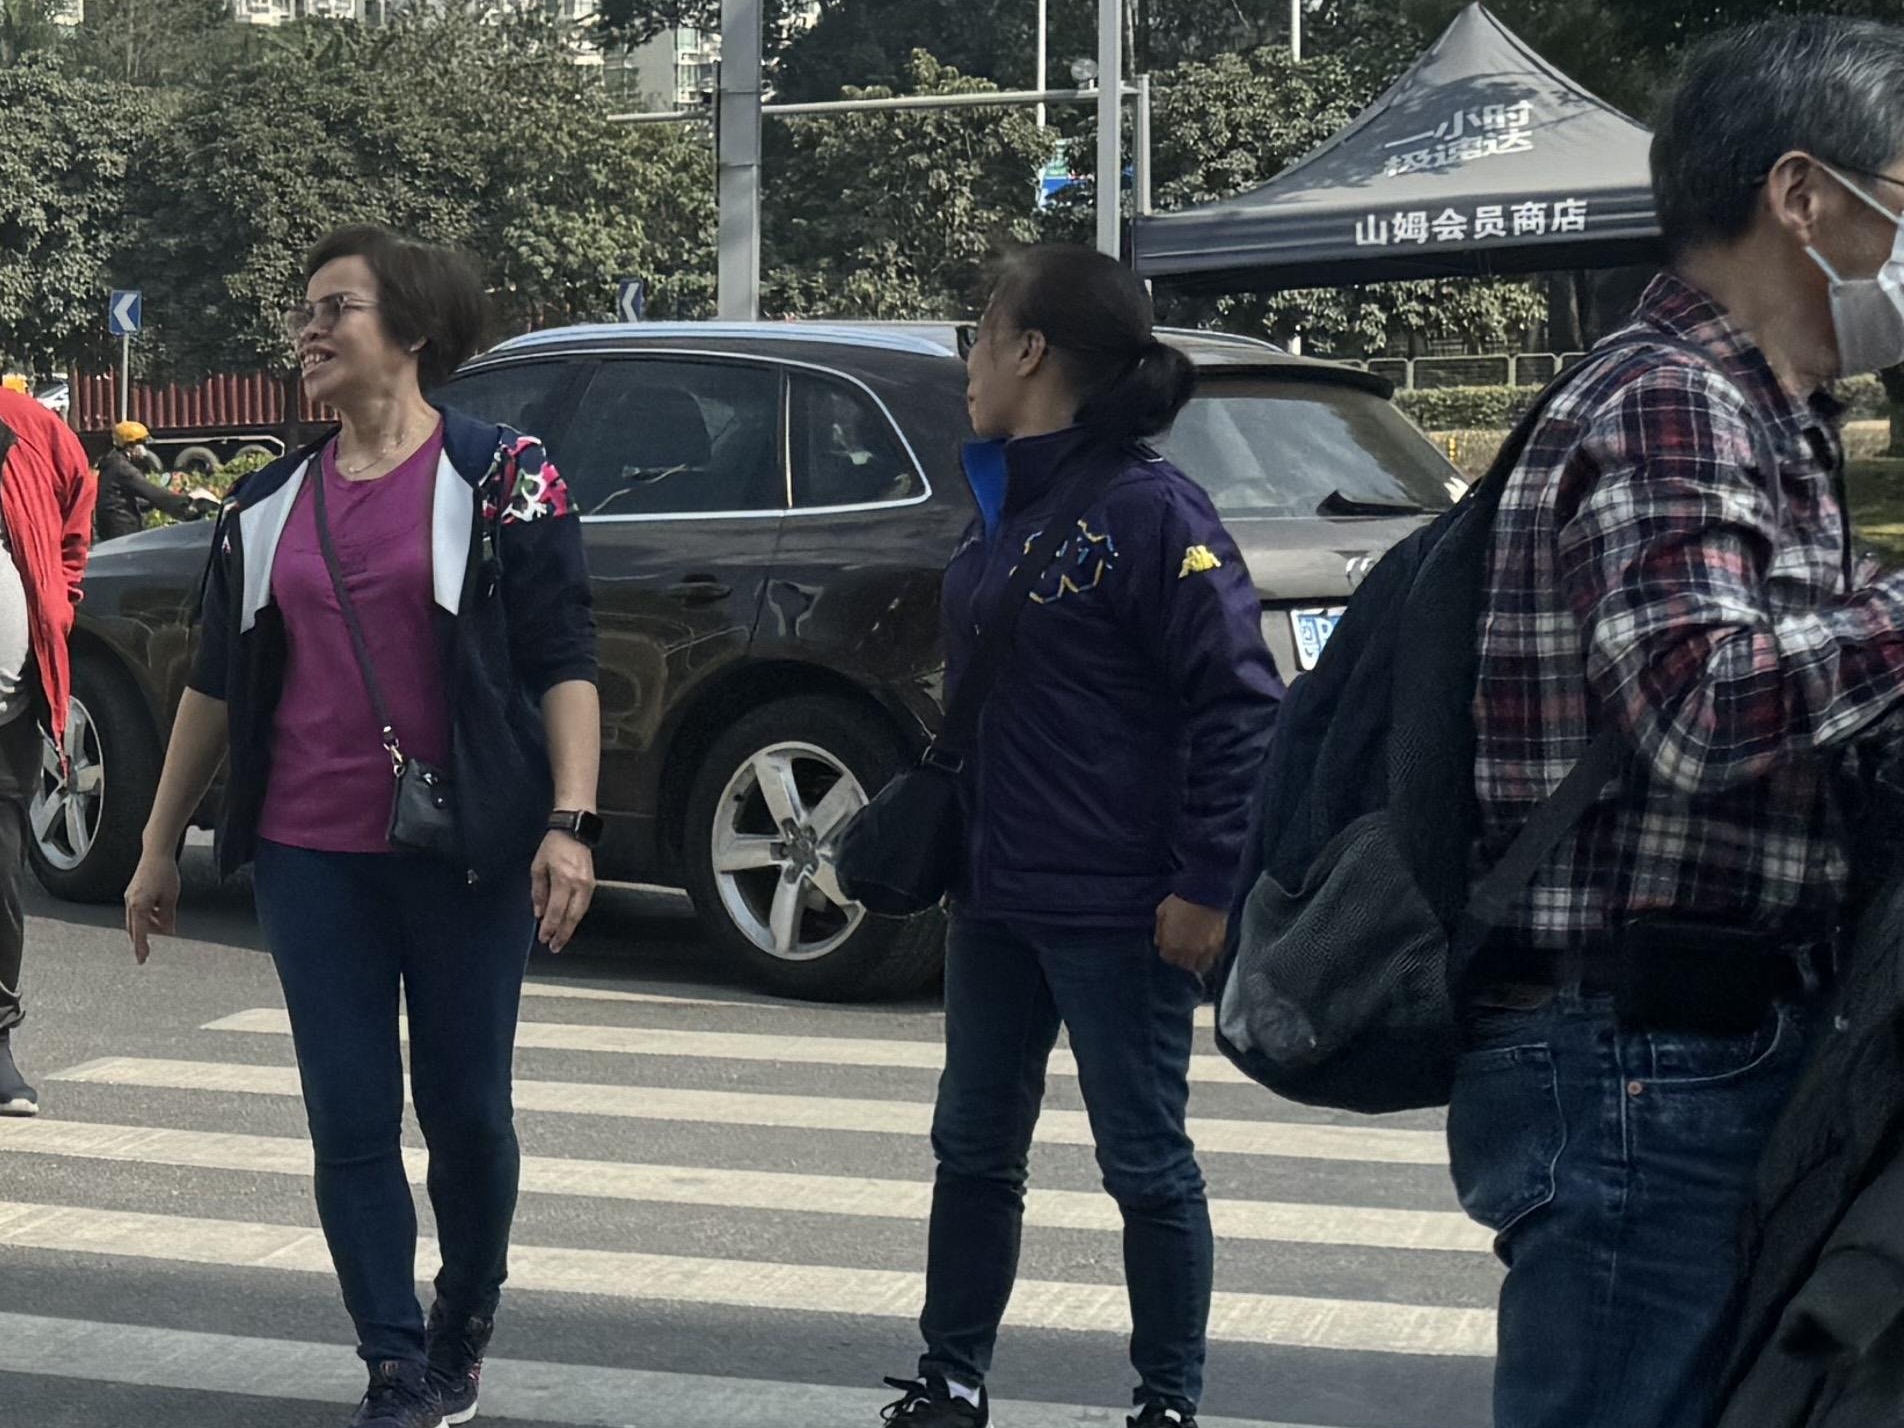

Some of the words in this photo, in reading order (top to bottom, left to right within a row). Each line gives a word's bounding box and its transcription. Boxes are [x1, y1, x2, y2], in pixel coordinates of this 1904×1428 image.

[1383, 99, 1534, 149] 一小时
[1382, 128, 1534, 178] 极速达
[1354, 196, 1589, 247] 山姆会员商店
